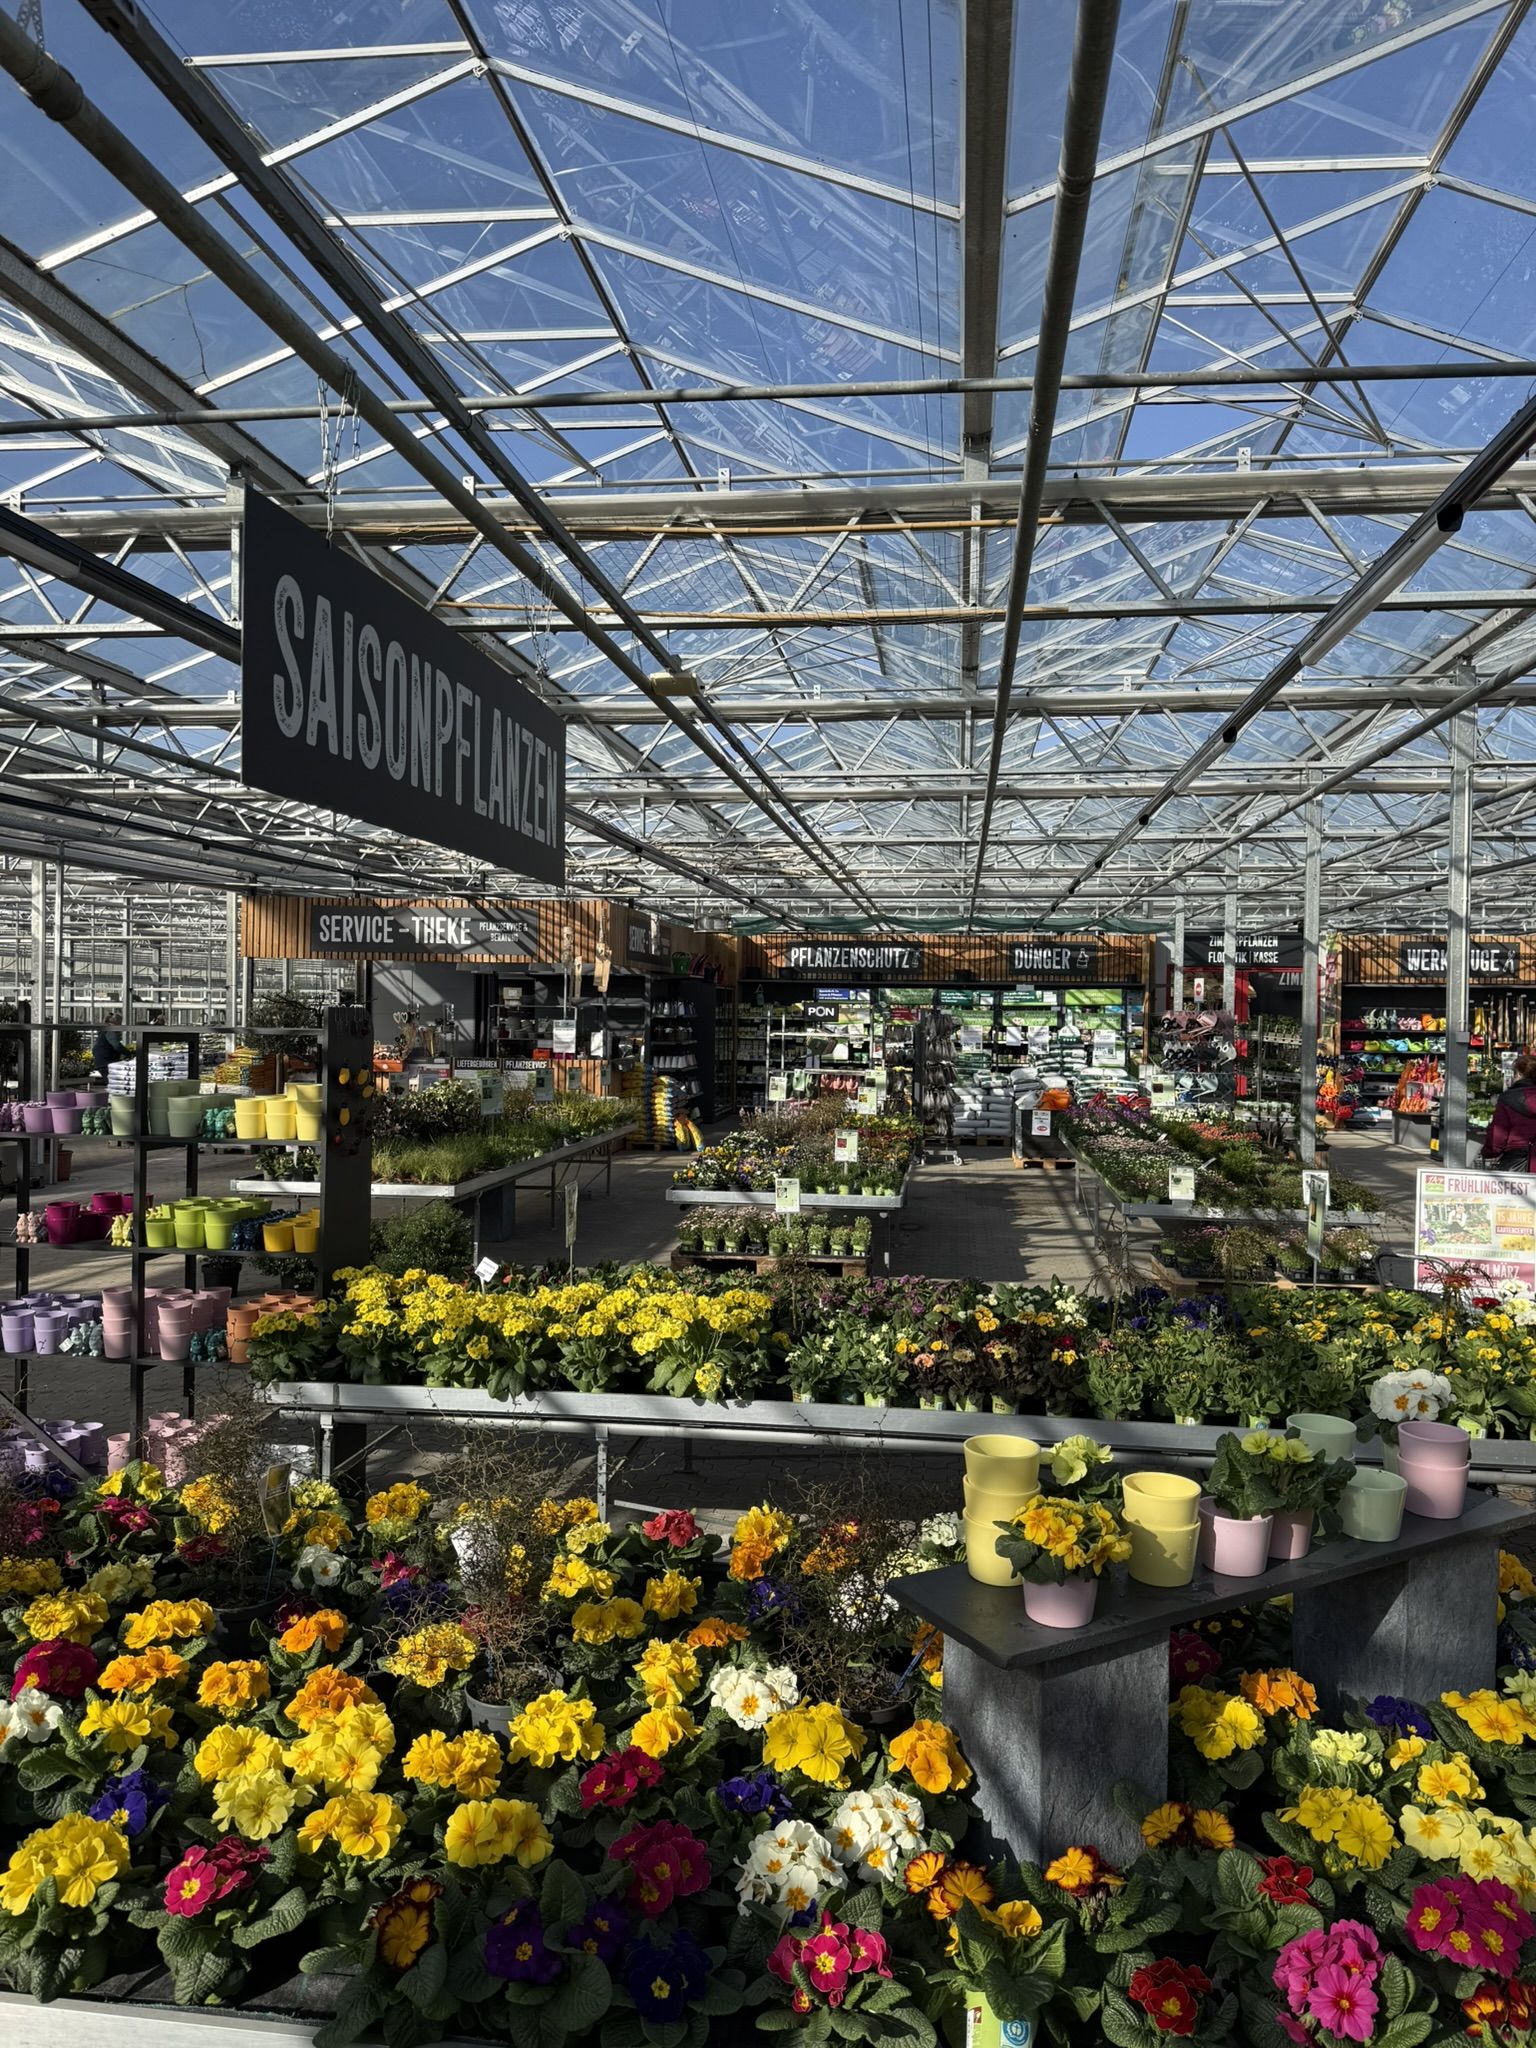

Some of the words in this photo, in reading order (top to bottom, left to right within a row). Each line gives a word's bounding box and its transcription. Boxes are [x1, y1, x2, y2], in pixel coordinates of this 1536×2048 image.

[273, 574, 558, 848] SAISONPFLANZEN
[319, 914, 395, 943] SERVICE
[411, 916, 472, 945] THEKE
[790, 946, 911, 969] PFLANZENSCHUTZ
[1014, 944, 1070, 969] DÜNGER
[1253, 951, 1279, 963] KASSE
[1407, 948, 1500, 972] WERKUGE
[807, 1005, 835, 1017] PON
[1448, 1176, 1530, 1196] FRÜHLINGSFEST
[1506, 1211, 1534, 1224] JAHRE
